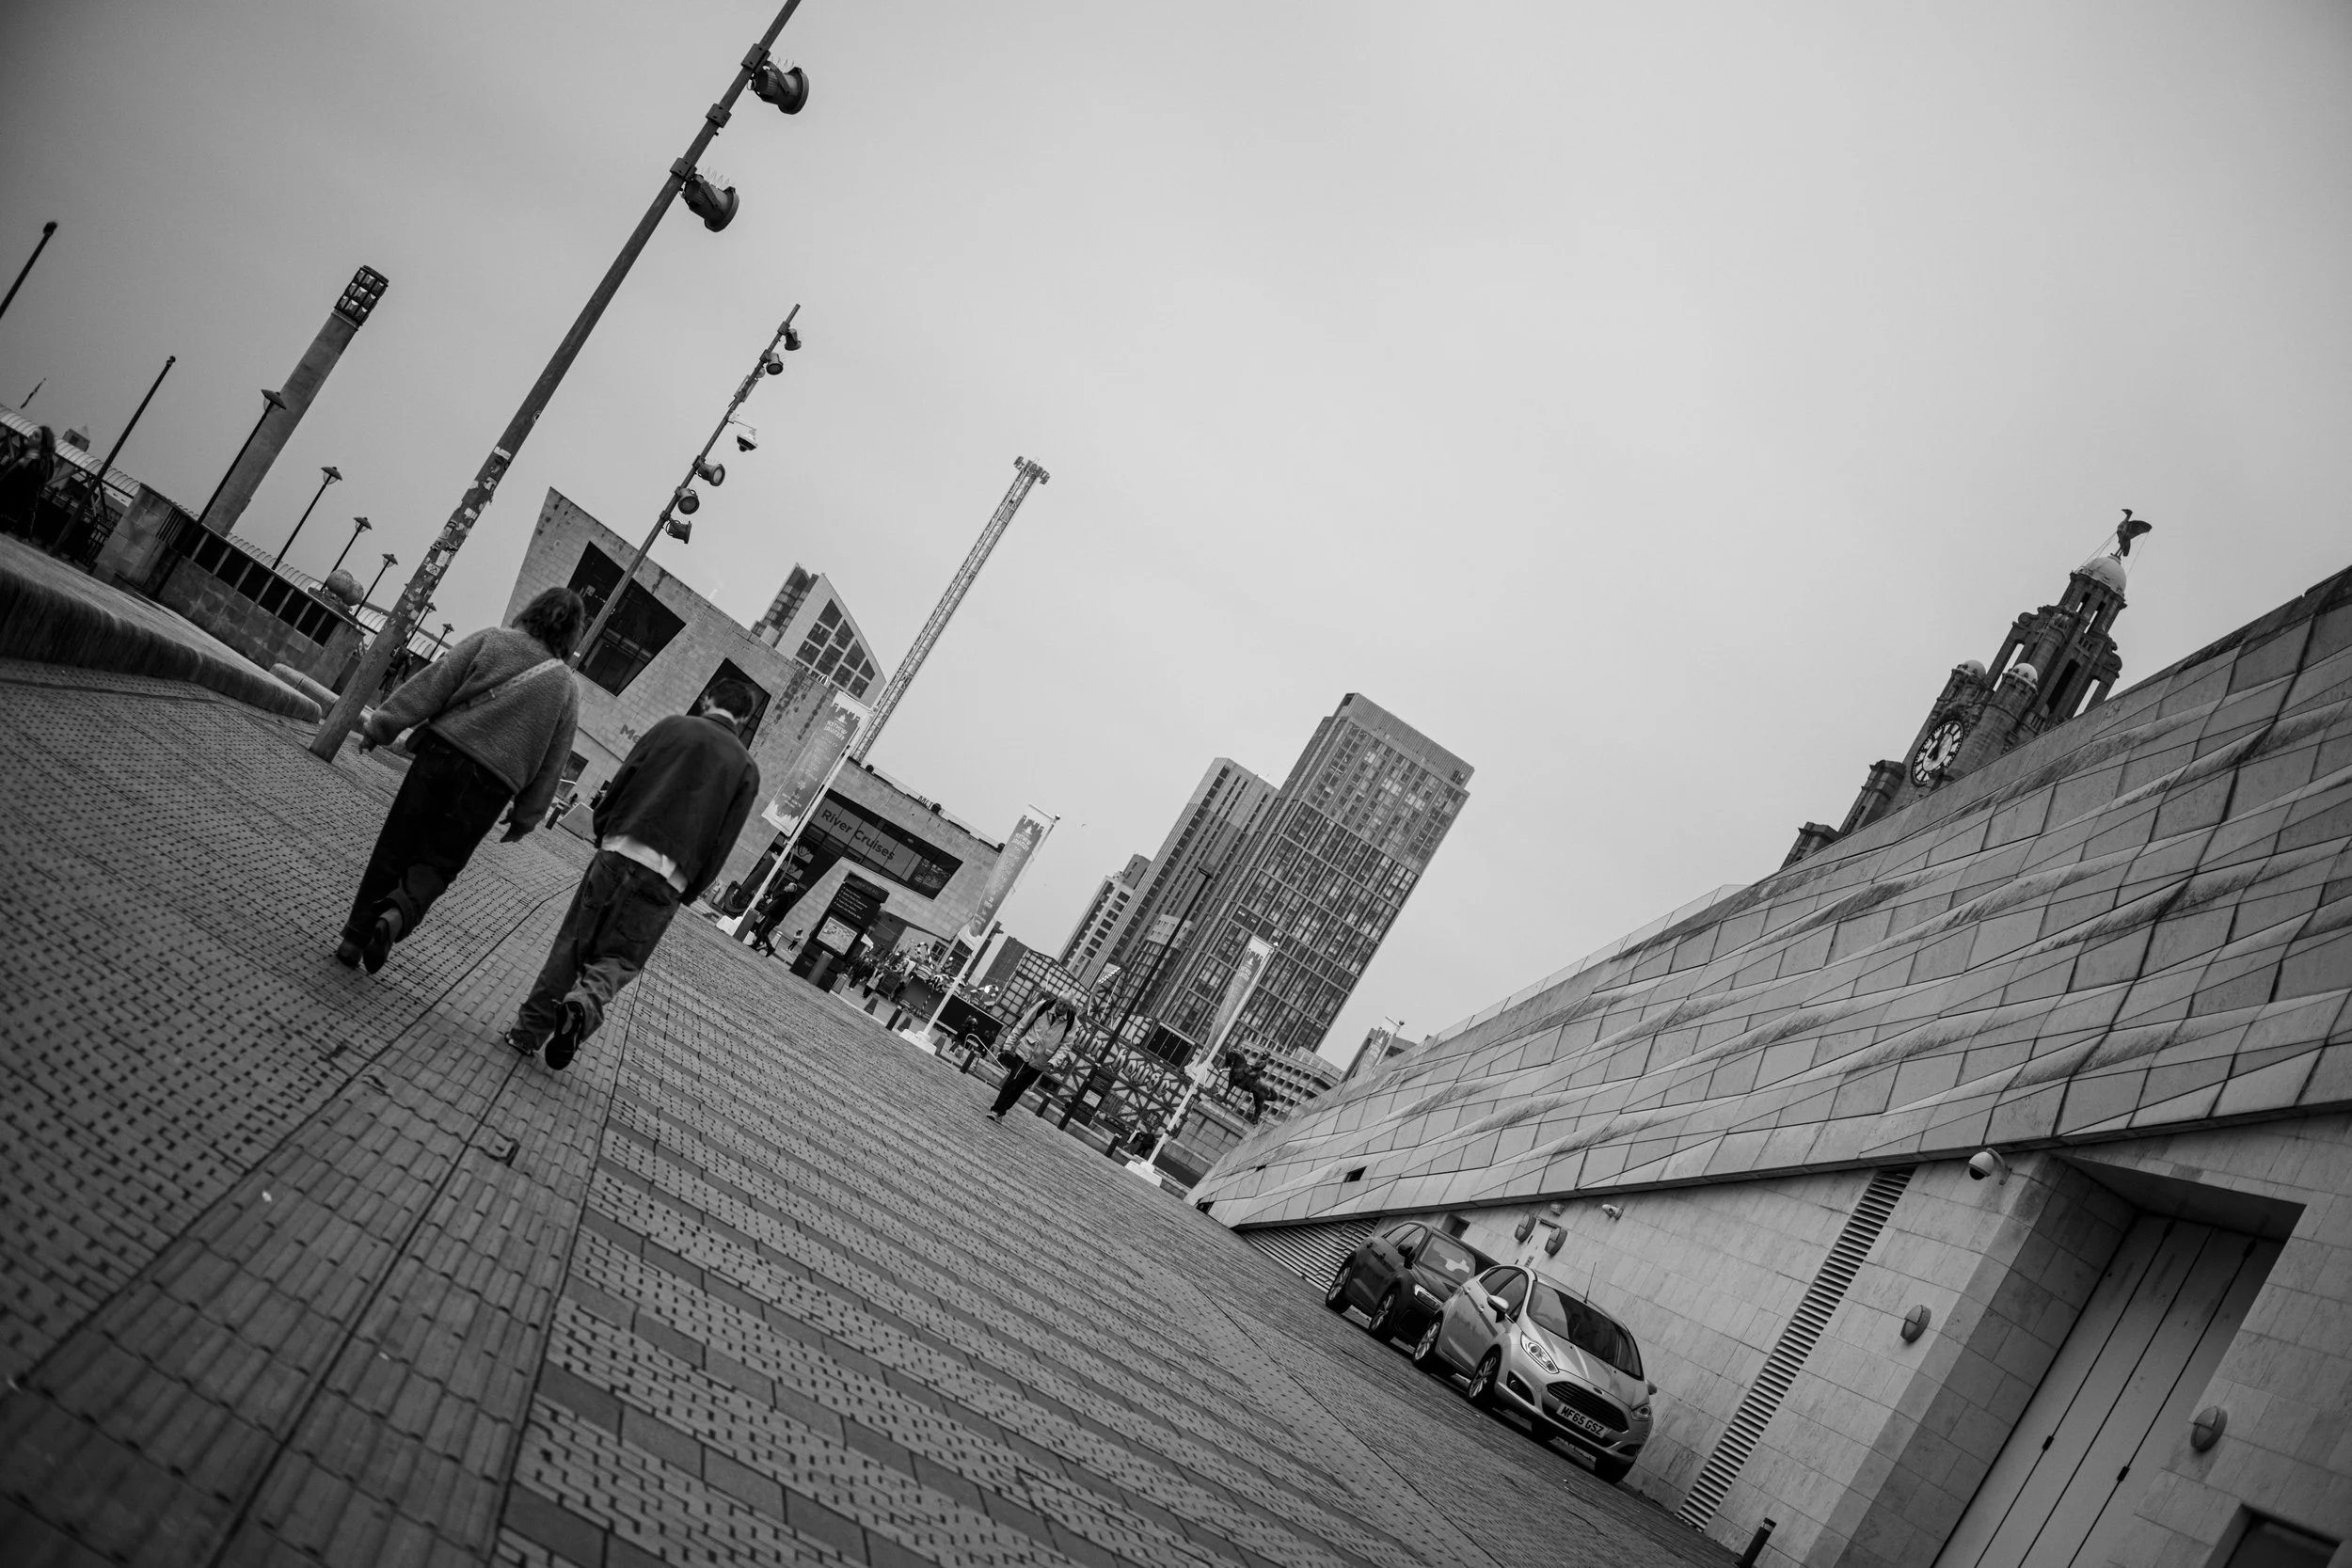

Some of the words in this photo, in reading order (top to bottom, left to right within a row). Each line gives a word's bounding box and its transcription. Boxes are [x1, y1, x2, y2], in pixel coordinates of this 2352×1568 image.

[821, 809, 852, 832] River
[853, 830, 895, 860] Cruises
[1073, 1026, 1104, 1055] un
[1561, 1406, 1586, 1425] MF65
[1585, 1420, 1604, 1435] GSZ
